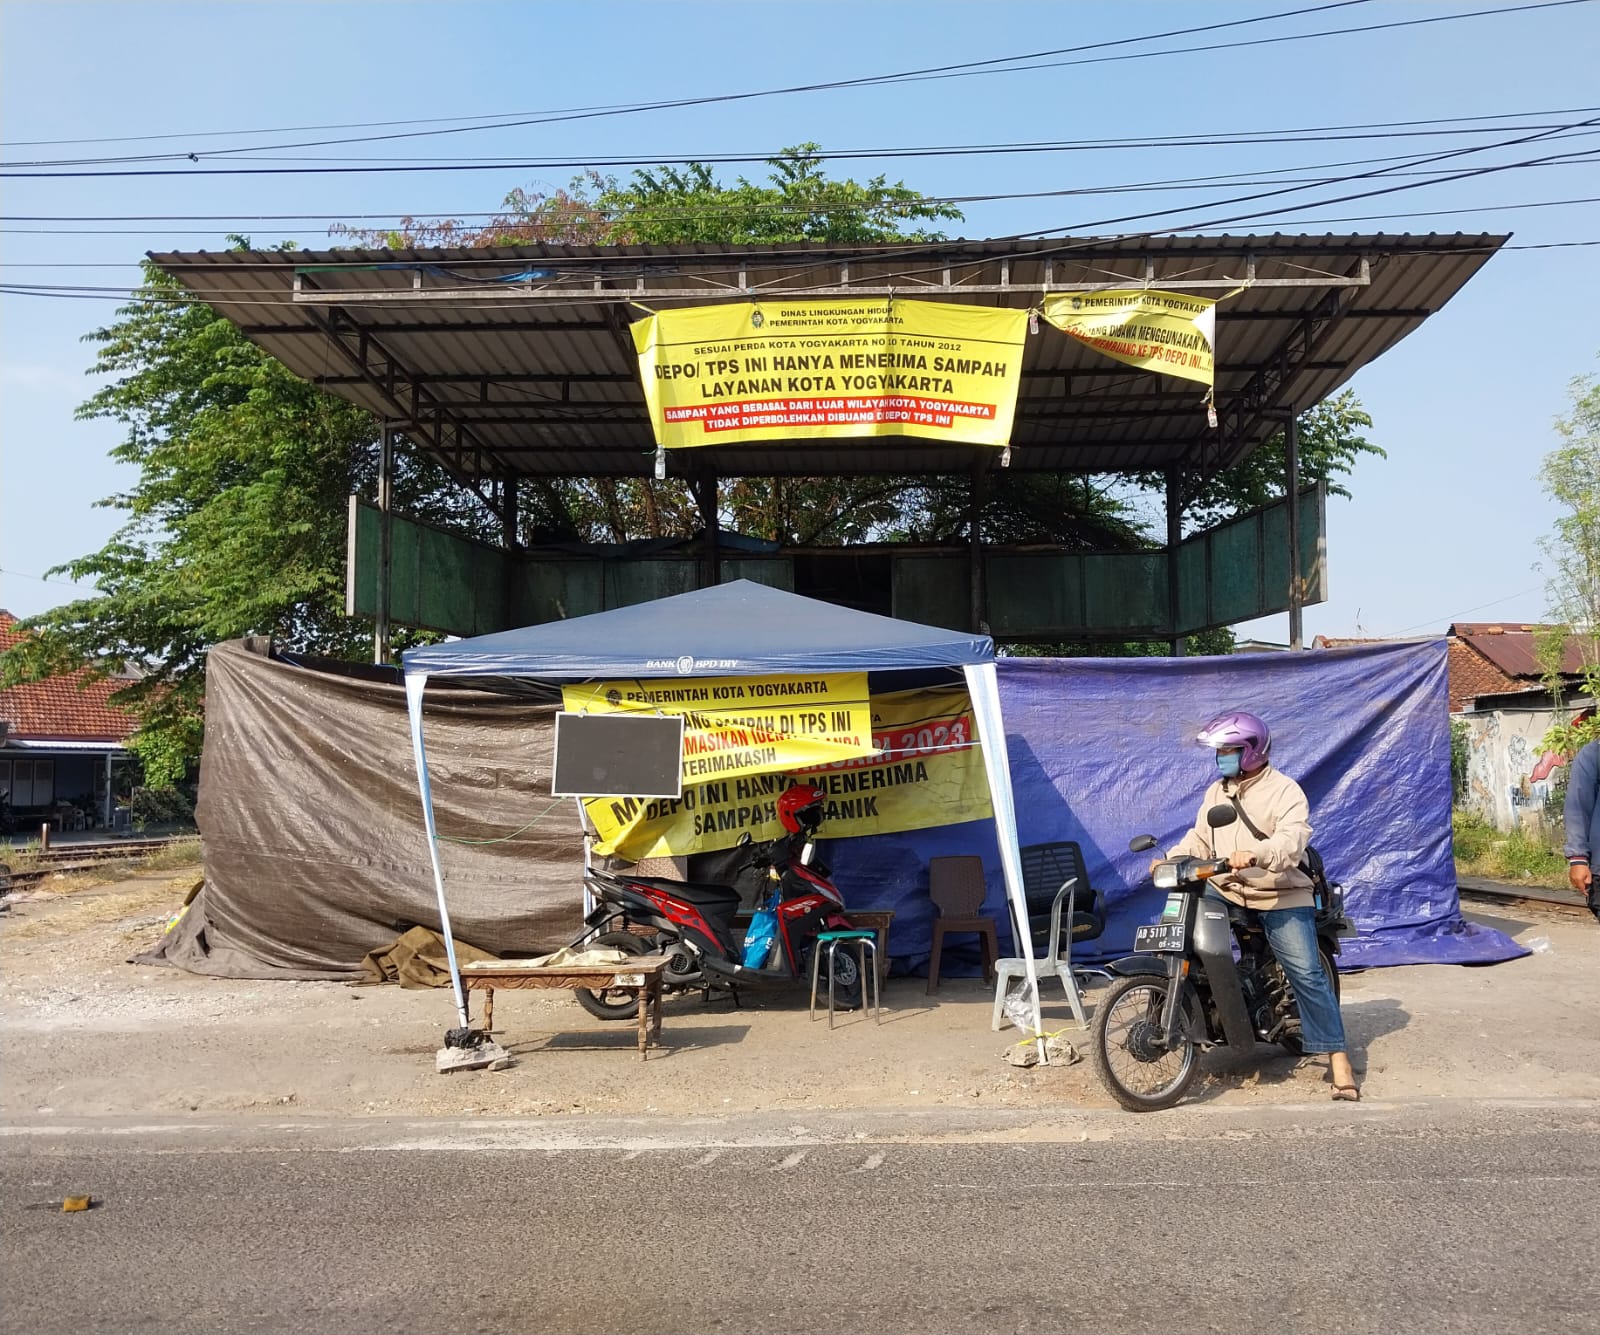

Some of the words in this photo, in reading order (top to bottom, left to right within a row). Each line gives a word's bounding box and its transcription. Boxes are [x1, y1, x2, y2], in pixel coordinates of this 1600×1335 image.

[781, 309, 807, 317] DINAS
[809, 307, 865, 317] LINGKUNGAN
[867, 307, 893, 315] HIDUP
[1163, 298, 1209, 314] YOGYAKAR
[769, 319, 824, 327] PEMERINTAH
[826, 318, 848, 326] KOTA
[851, 317, 904, 325] YOGYAKARTA
[694, 346, 731, 355] SESUAI
[734, 342, 766, 350] PERDA
[768, 341, 796, 349] KOTA
[800, 338, 868, 348] YOGYAKARTA
[872, 338, 885, 346] NO
[900, 338, 935, 348] TAHUN
[938, 342, 962, 351] 2012
[1138, 325, 1200, 350] MENGGUNAKAN
[1137, 344, 1148, 358] KE
[1149, 345, 1165, 361] TPS
[1165, 348, 1188, 366] DEPO
[655, 362, 700, 379] DEPO/
[705, 359, 740, 375] TPS
[745, 356, 767, 372] INI
[773, 355, 834, 371] HANYA
[840, 354, 928, 370] MENERIMA
[933, 356, 1007, 377] SAMPAH
[702, 377, 782, 398] LAYANAN
[788, 376, 836, 392] KOTA
[841, 374, 954, 394] YOGYAKARTA
[666, 407, 708, 420] SAMPAH
[710, 404, 741, 416] YANG
[743, 401, 787, 413] BERASAL
[789, 400, 813, 411] DARI
[816, 400, 844, 410] LUAR
[847, 399, 888, 409] WILAYAH
[889, 398, 917, 408] KOTA
[919, 400, 990, 417] YOGYAKARTA
[706, 418, 740, 429] TIDAK
[742, 412, 825, 426] DIPERBOLEHKAN
[828, 411, 874, 422] DIBUANG
[914, 411, 933, 422] TPS
[935, 414, 951, 425] INI
[646, 660, 676, 668] BANK
[695, 659, 718, 668] BPD
[719, 659, 739, 668] DIY
[627, 687, 709, 703] PEMERINTAH
[713, 684, 745, 700] KOTA
[747, 681, 829, 697] YOGYAKARTA
[683, 711, 712, 731] ANG
[780, 714, 794, 734] DI
[799, 712, 827, 734] TPS
[831, 710, 851, 732] INI
[684, 729, 749, 758] MASIKAN
[902, 722, 965, 758] 2023
[683, 747, 776, 778] TERIMAKASIH
[646, 789, 696, 822] DEPO
[700, 782, 728, 806] INI
[809, 760, 929, 796] MENERIMA
[694, 801, 777, 836] SAMPAH
[1138, 928, 1148, 939] AB
[1171, 925, 1183, 937] YF
